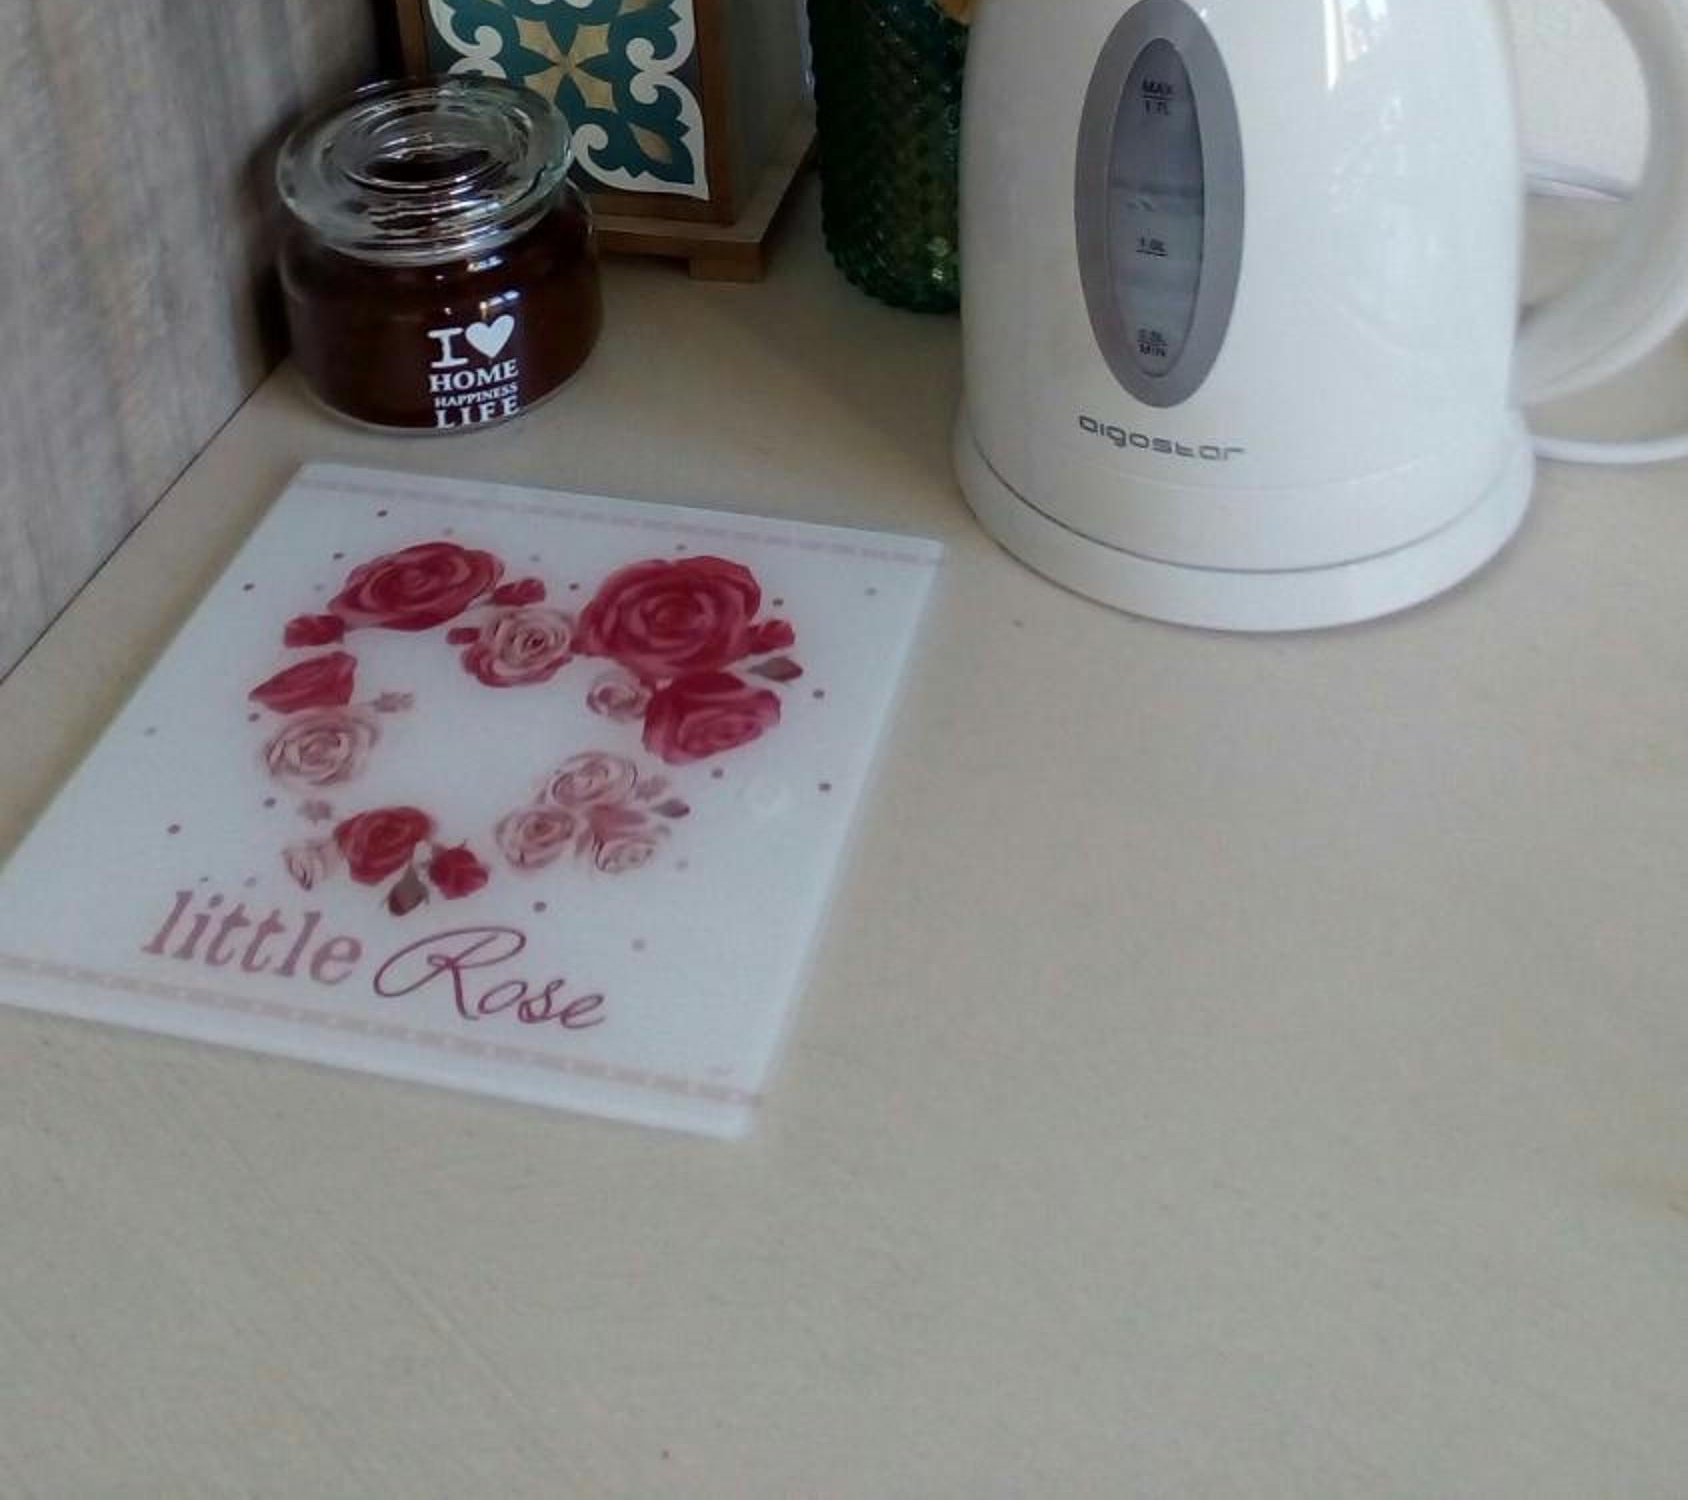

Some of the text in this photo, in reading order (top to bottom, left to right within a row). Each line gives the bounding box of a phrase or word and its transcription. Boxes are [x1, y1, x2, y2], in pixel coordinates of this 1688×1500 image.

[427, 326, 470, 369] I
[428, 358, 520, 393] HOME
[434, 381, 519, 408] HAPPINESS
[435, 394, 520, 429] LIFE
[1078, 414, 1246, 461] aigostar
[141, 890, 606, 1030] little Rose
